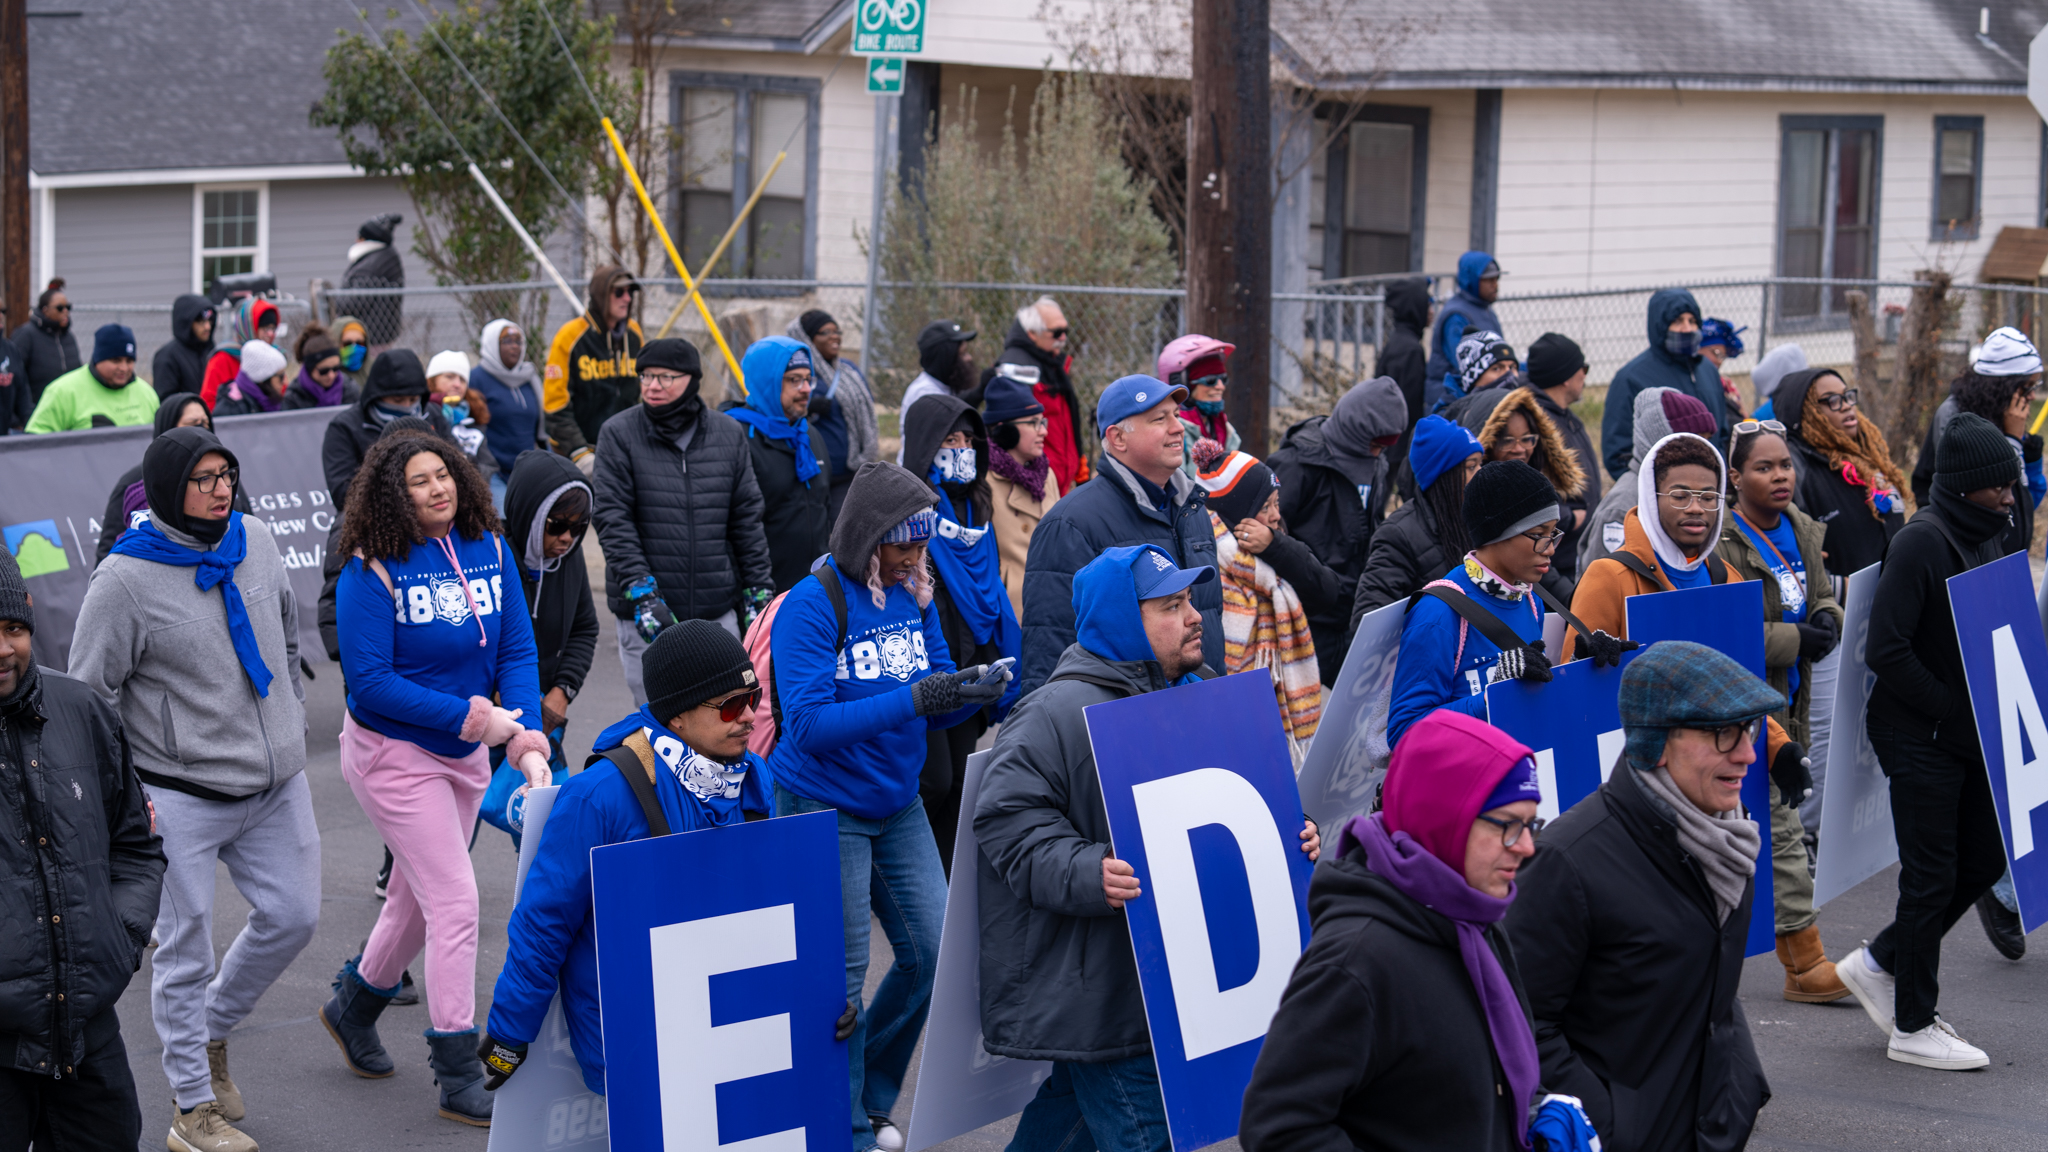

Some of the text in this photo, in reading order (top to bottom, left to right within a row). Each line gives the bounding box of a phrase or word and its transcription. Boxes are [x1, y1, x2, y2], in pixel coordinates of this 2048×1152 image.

[857, 33, 920, 51] BIKE ROUTE
[650, 903, 807, 1152] E
[1131, 767, 1301, 1062] D
